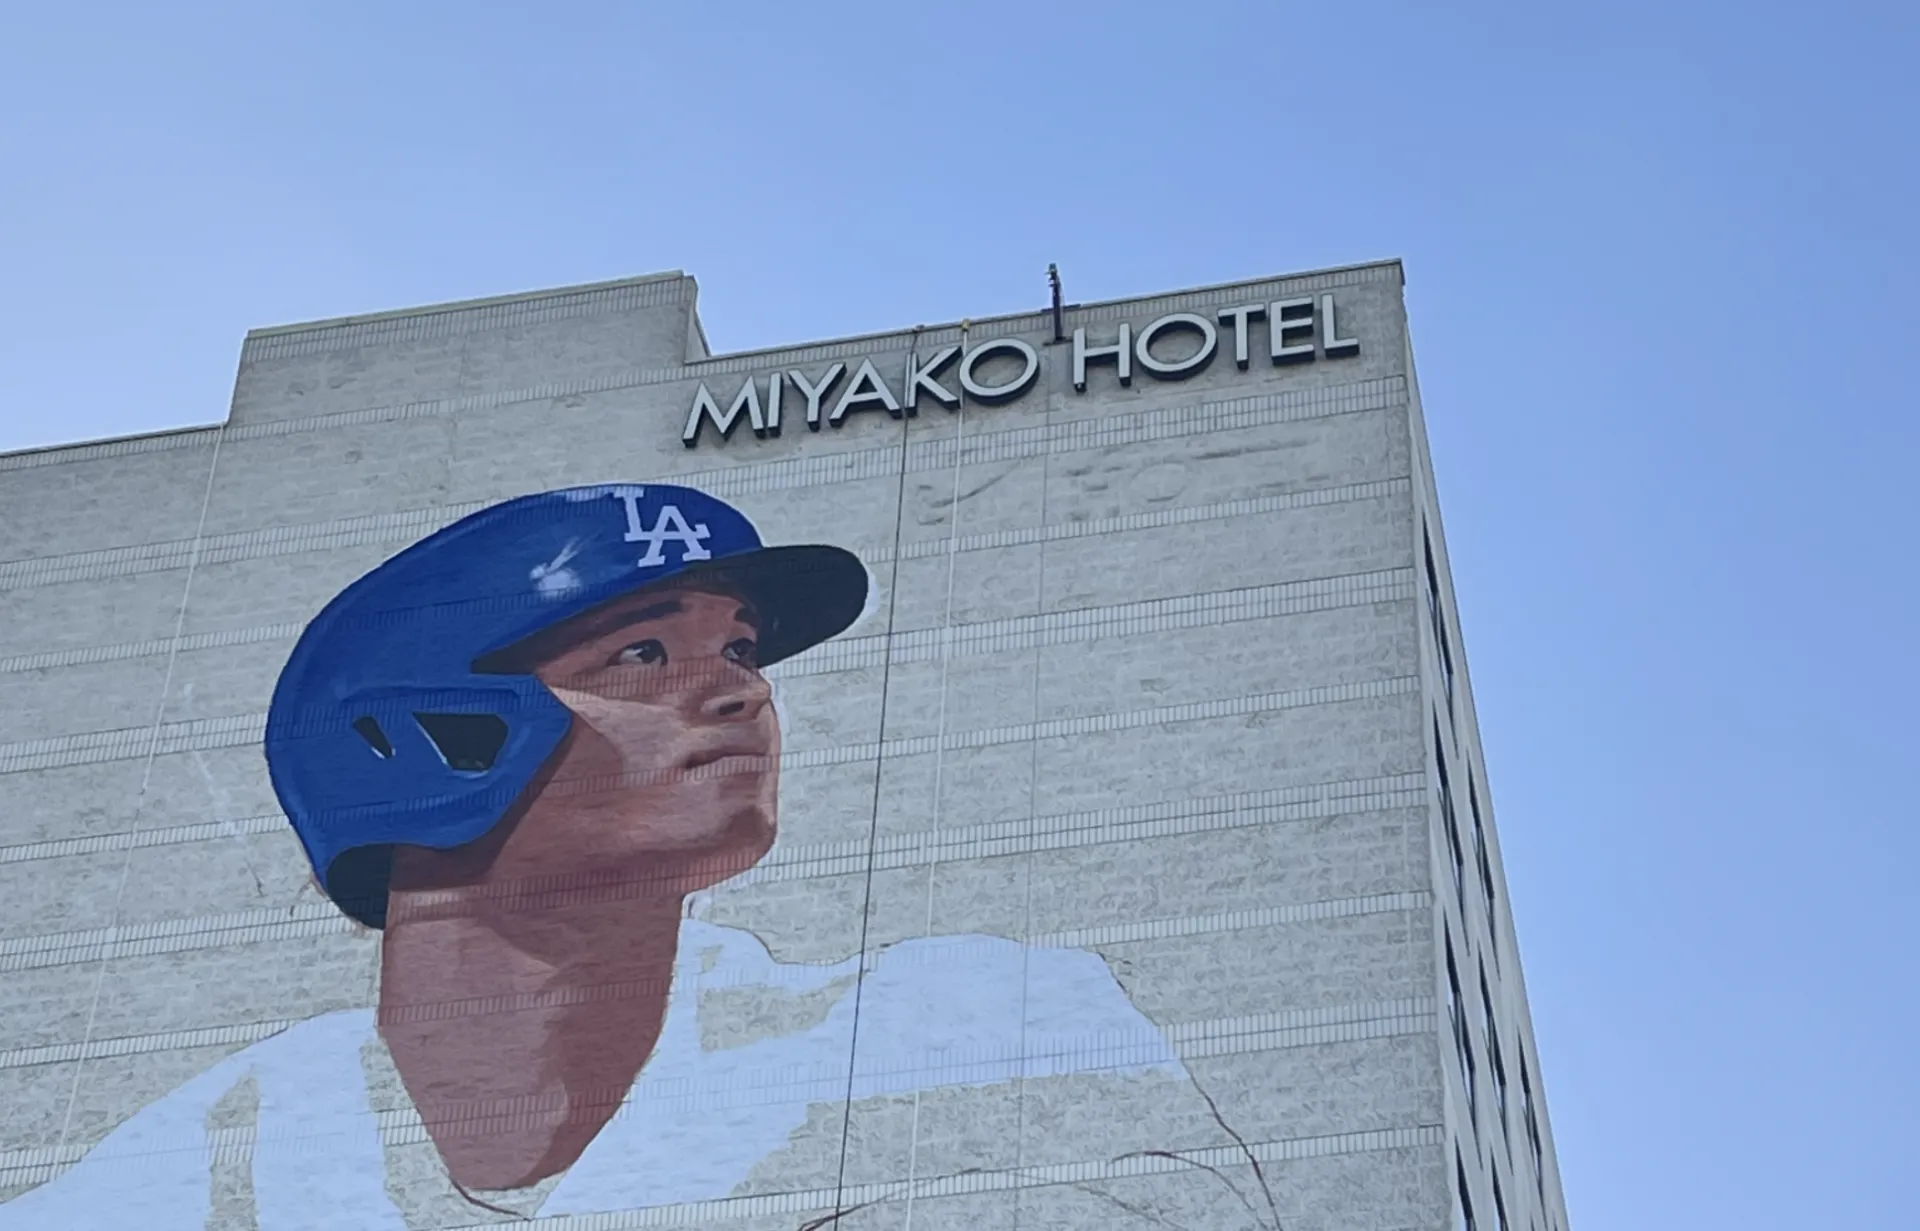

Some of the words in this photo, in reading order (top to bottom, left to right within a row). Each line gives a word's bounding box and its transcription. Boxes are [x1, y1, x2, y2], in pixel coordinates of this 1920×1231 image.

[683, 339, 1039, 447] MIYAKO
[1073, 295, 1360, 392] HOTEL
[614, 486, 711, 567] LA
